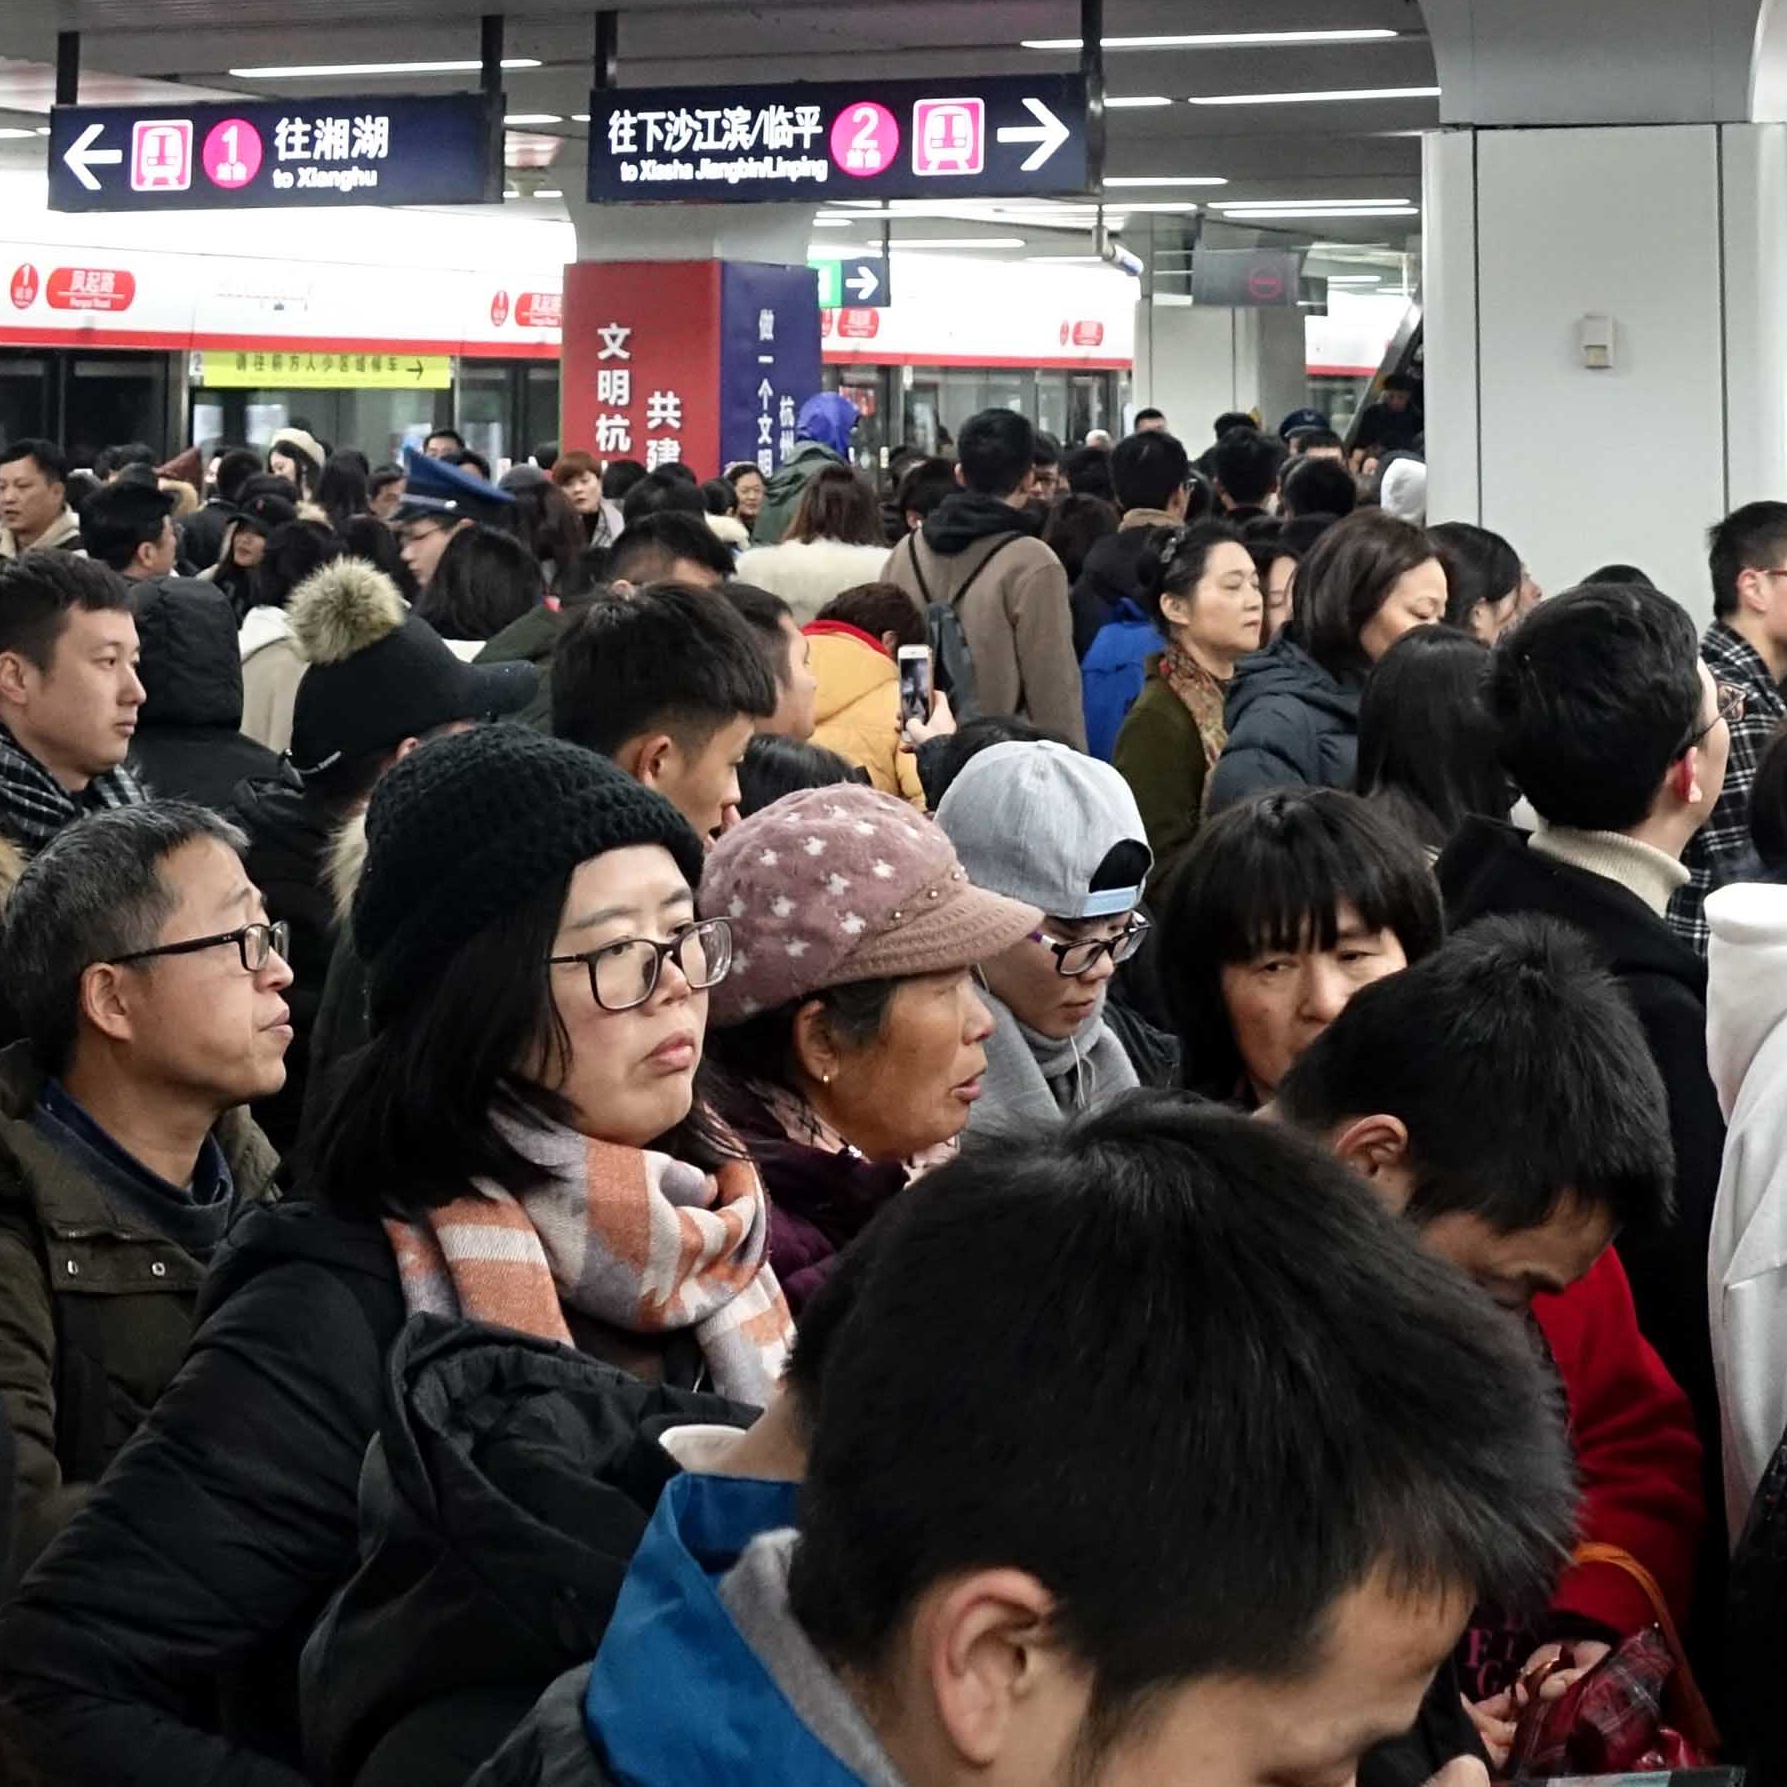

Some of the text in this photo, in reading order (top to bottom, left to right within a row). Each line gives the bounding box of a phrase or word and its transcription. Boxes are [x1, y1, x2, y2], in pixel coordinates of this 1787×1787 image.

[221, 125, 239, 165] 1
[274, 115, 389, 161] 往湘湖
[608, 105, 823, 153] 往下沙江滨/临平
[852, 107, 878, 148] 2
[595, 322, 632, 474] 文明杭
